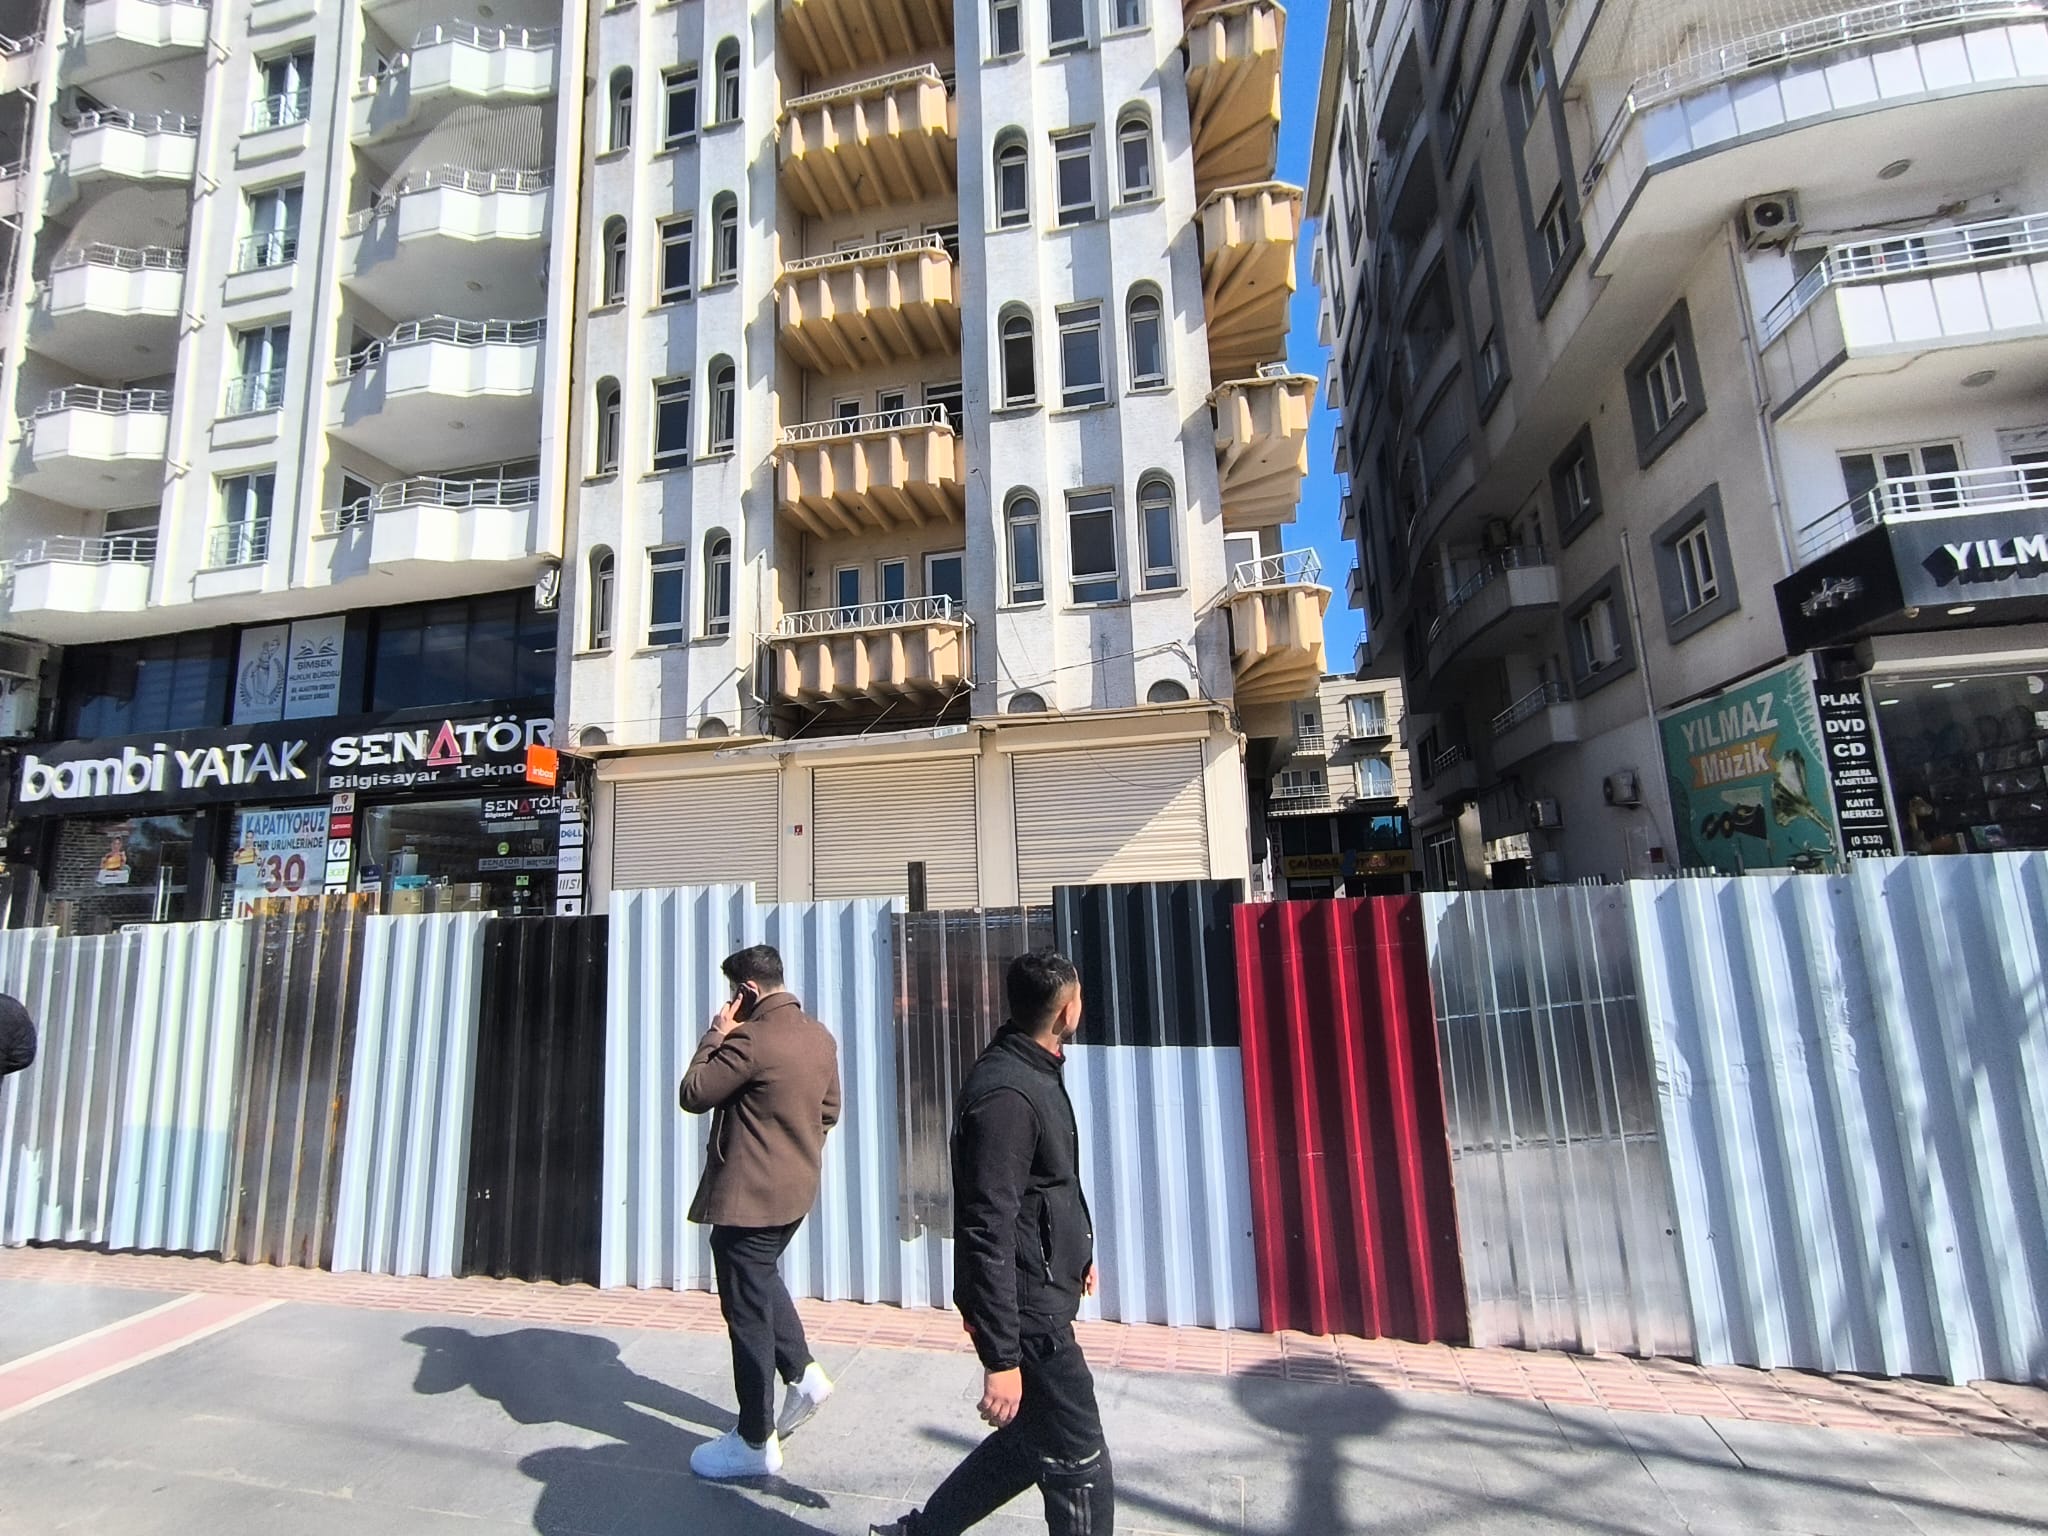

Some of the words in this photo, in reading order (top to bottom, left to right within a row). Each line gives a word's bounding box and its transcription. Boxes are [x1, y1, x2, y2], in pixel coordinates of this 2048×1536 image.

[1820, 693, 1862, 707] PLAK
[1681, 692, 1779, 753] YILMAZ
[1825, 719, 1866, 734] DVD
[328, 715, 555, 767] SENATÖR
[1833, 742, 1866, 757] CD
[1700, 742, 1770, 784] Müzik
[20, 743, 167, 802] bambi
[175, 740, 308, 788] YATAK
[1839, 769, 1872, 777] KAMERA
[329, 770, 439, 790] Bilgisayar
[1846, 798, 1874, 808] KAYIT
[561, 829, 582, 838] DELL
[1851, 836, 1860, 847] (0
[1862, 835, 1883, 846] 532)
[1846, 850, 1863, 858] 457
[1866, 849, 1879, 858] 74
[1881, 848, 1892, 857] 12
